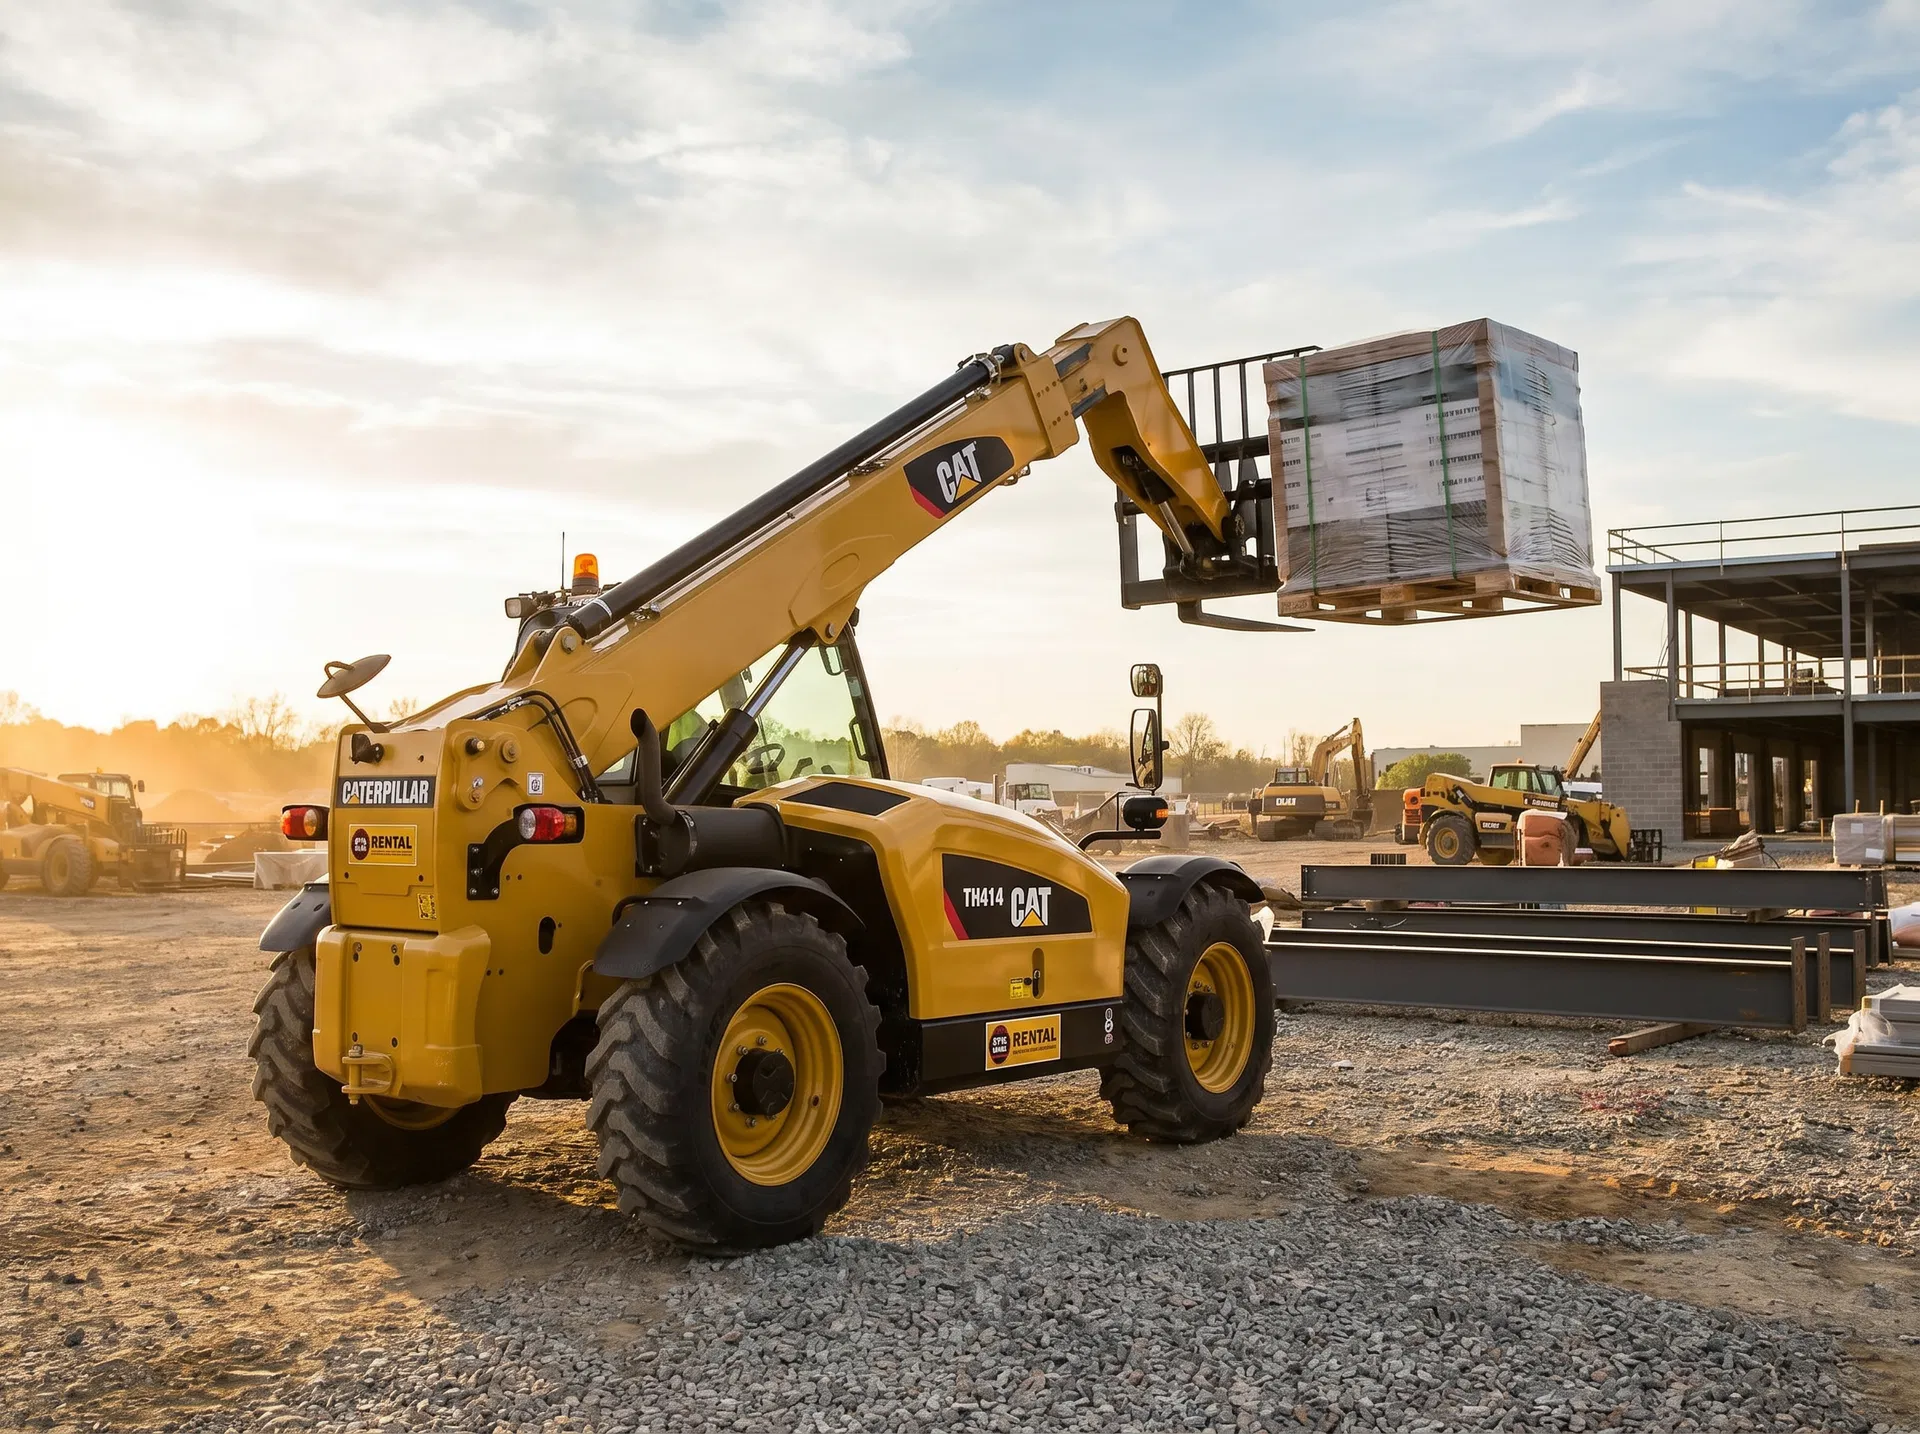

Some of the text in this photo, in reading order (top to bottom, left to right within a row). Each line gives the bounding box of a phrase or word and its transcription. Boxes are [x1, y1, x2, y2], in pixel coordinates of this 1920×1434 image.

[936, 442, 982, 504] CAT
[342, 780, 429, 804] CATERPILLAR
[371, 835, 412, 849] RENTAL
[963, 886, 1052, 928] TH414 CAT
[1012, 1027, 1057, 1048] RENTAL
